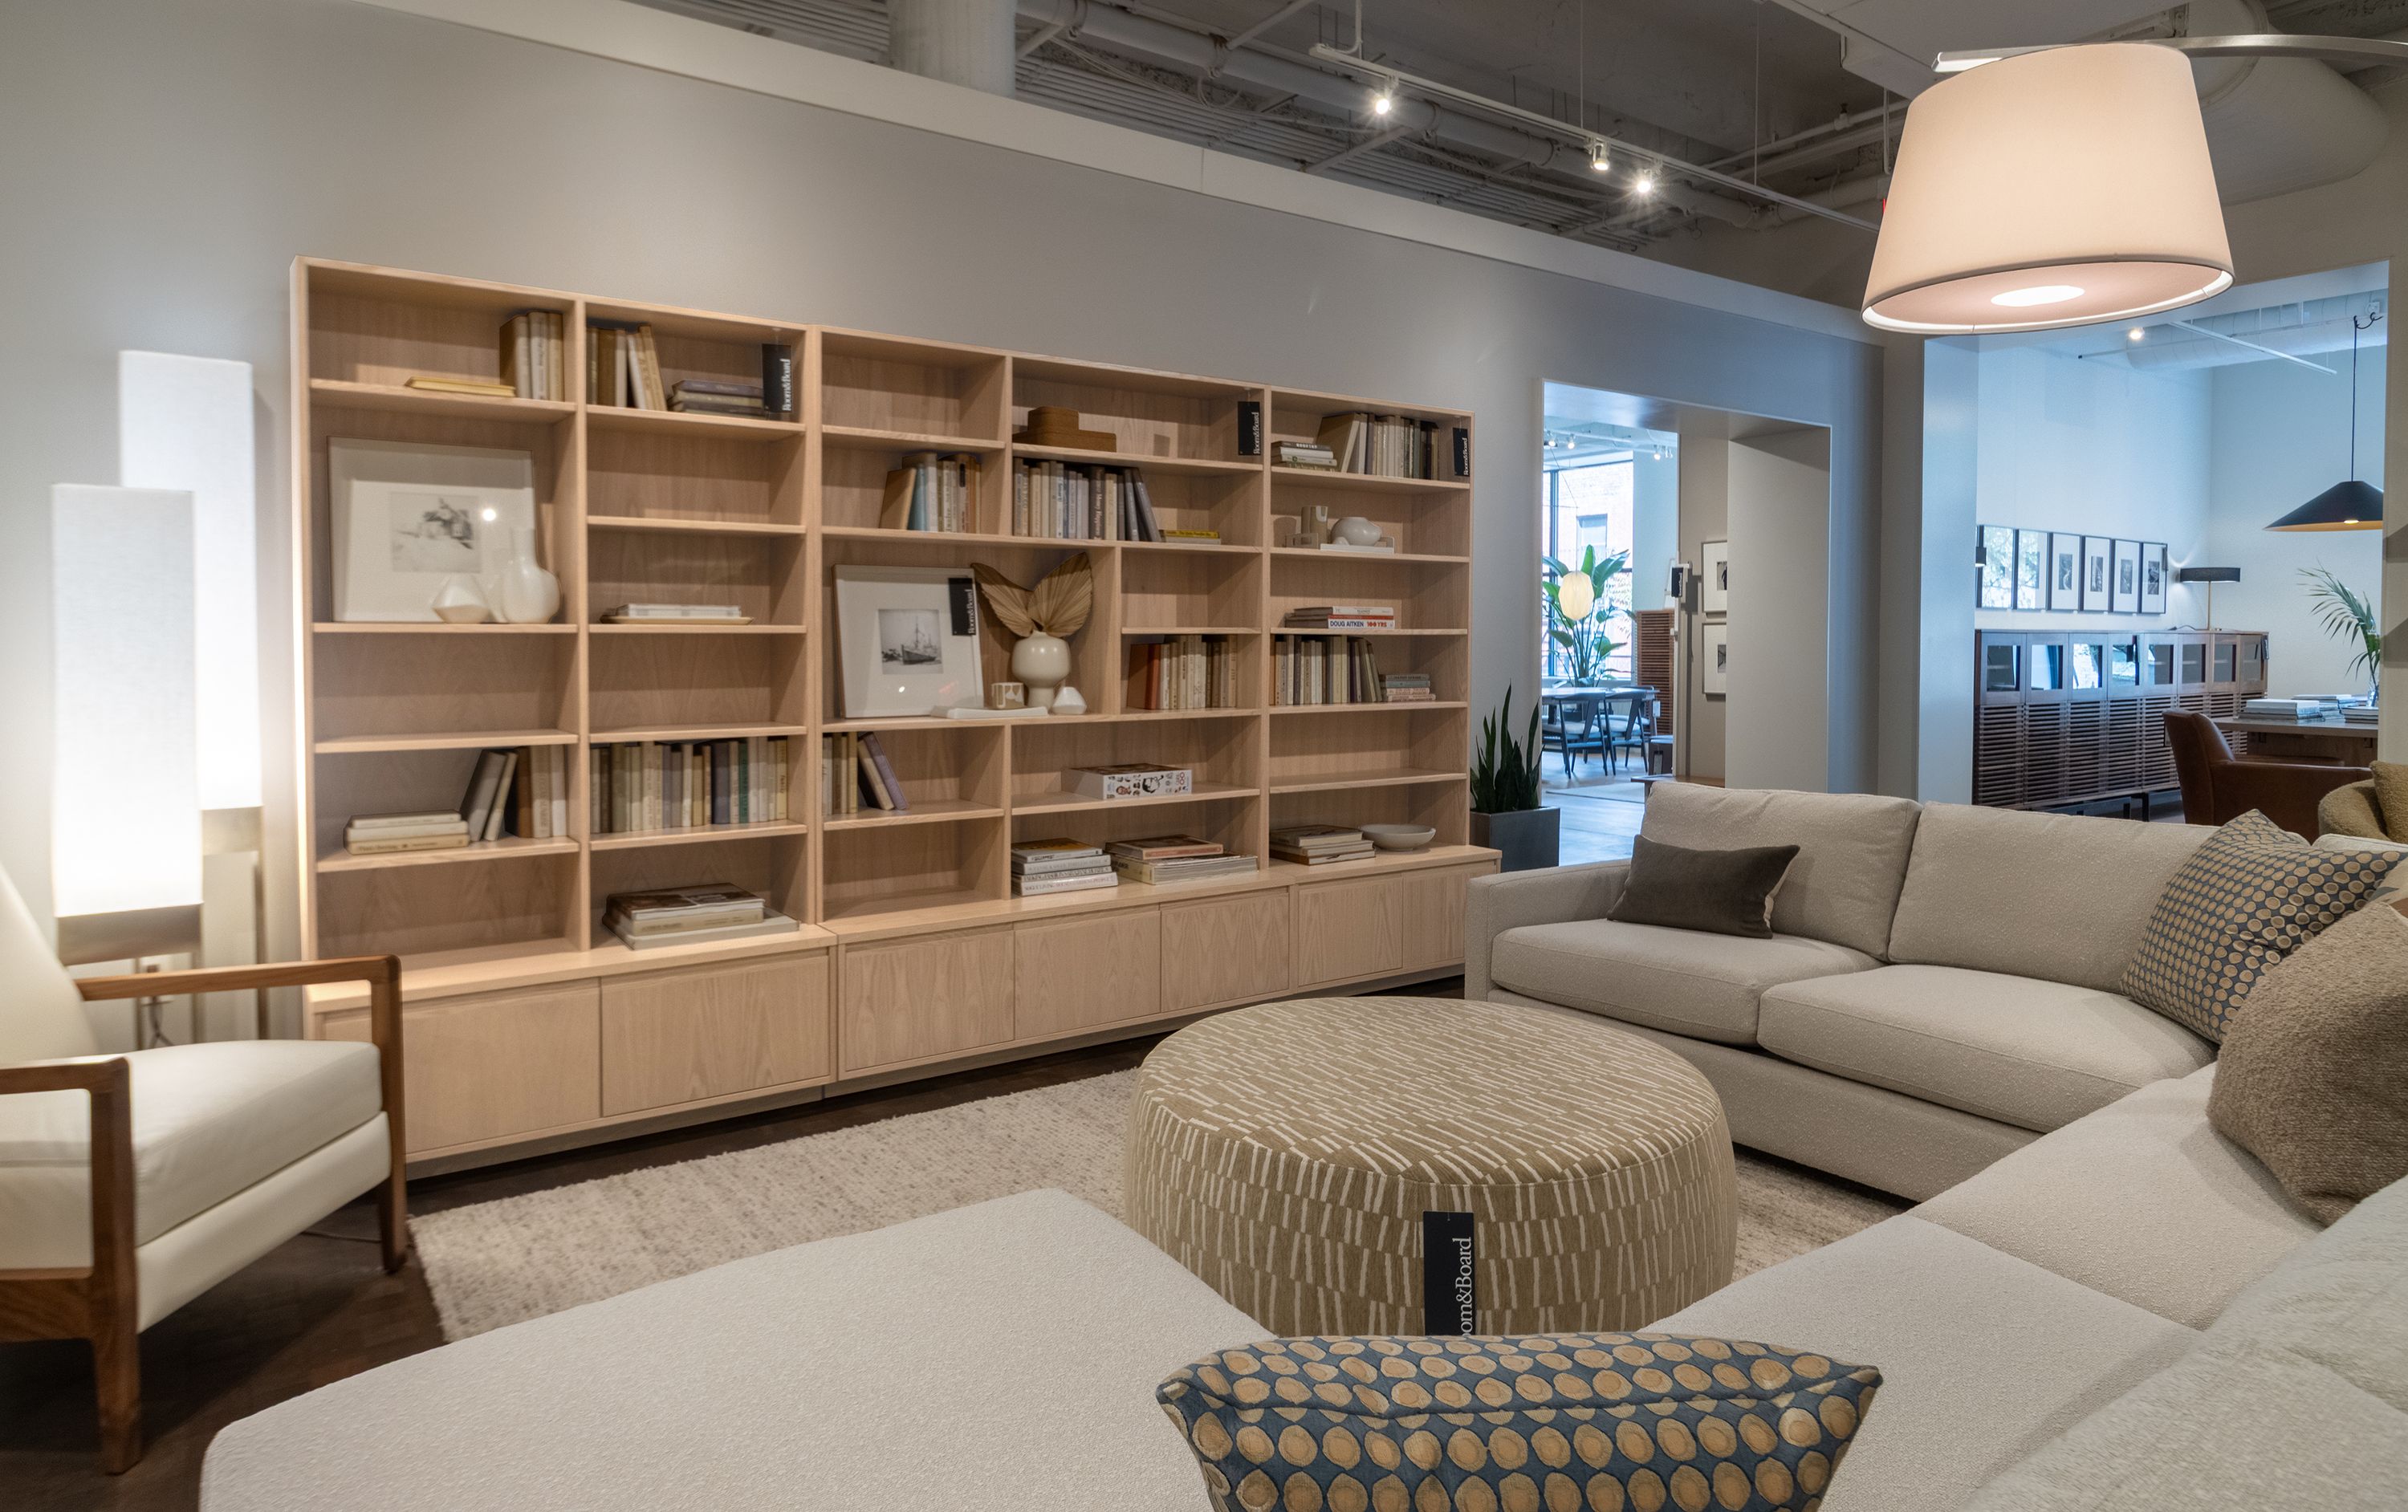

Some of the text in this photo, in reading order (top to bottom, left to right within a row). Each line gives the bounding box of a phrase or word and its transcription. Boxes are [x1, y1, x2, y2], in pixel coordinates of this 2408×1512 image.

[779, 359, 791, 411] Room&Board
[1252, 412, 1260, 453] Room&Board
[965, 589, 974, 633] Room&Board
[1452, 1237, 1472, 1336] om&Board
